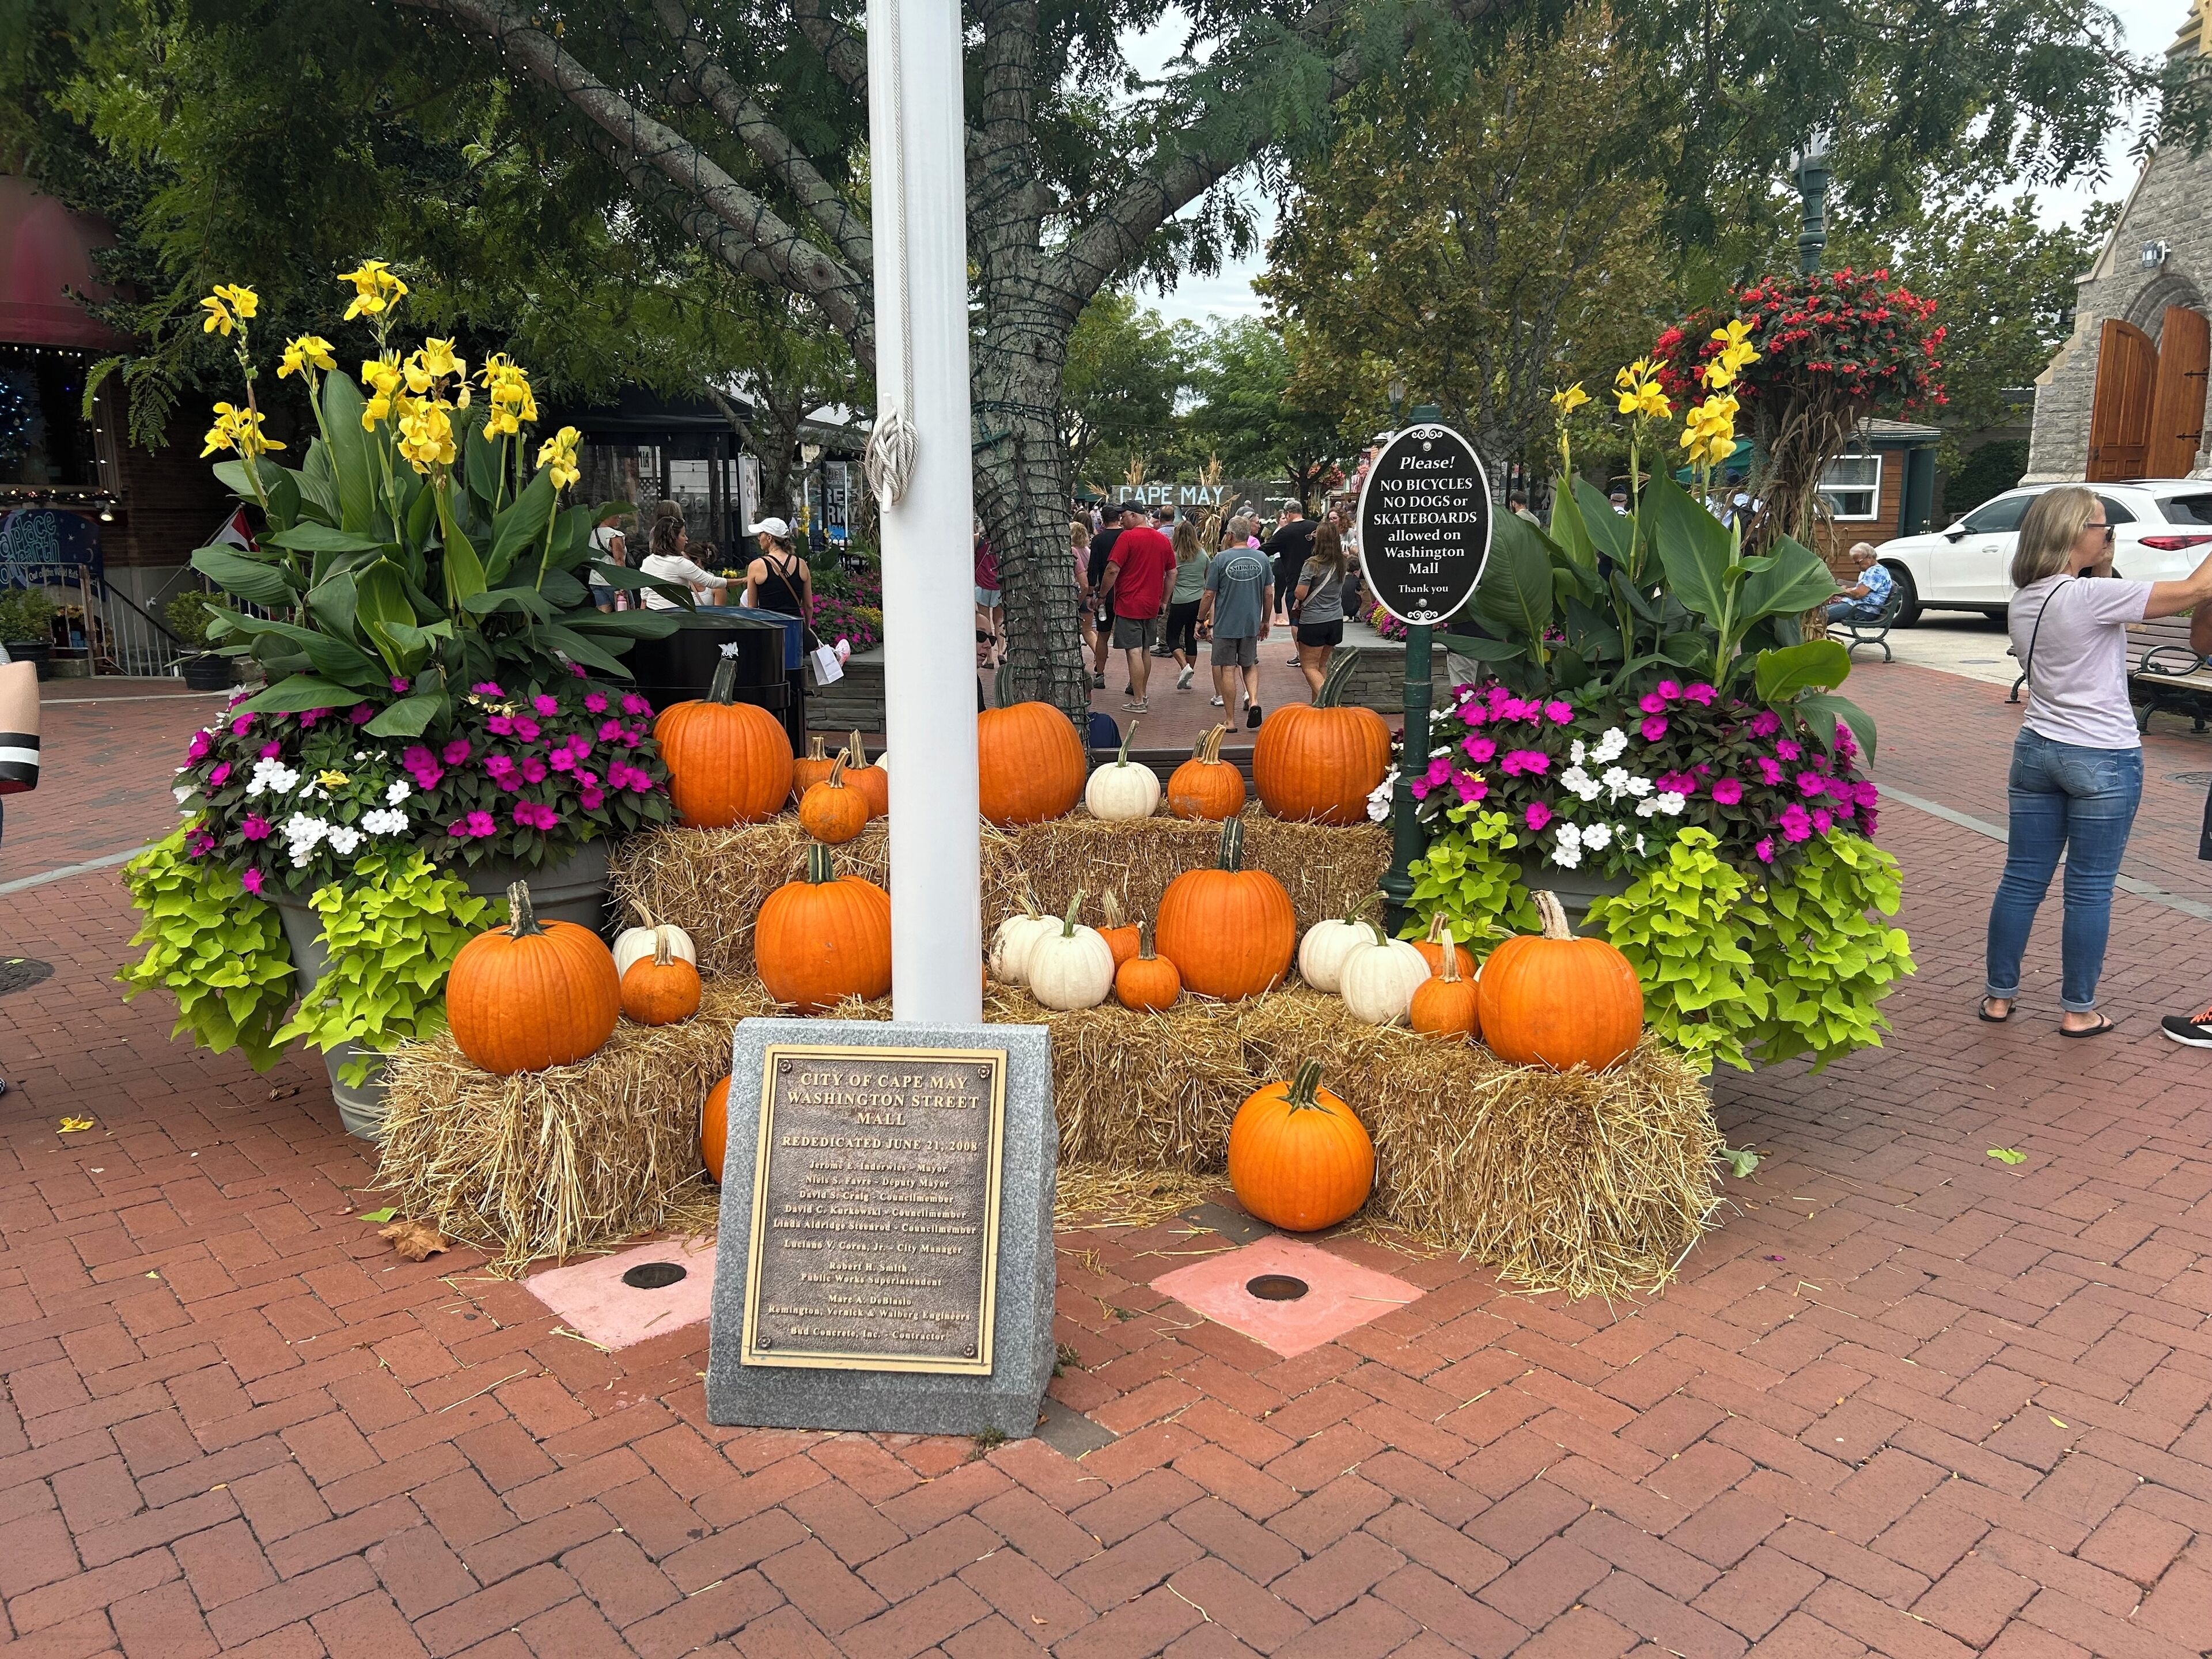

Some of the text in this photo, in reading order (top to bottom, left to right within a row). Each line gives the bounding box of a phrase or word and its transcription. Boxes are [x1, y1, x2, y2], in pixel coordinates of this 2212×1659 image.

[1399, 456, 1455, 470] Please!
[1380, 478, 1472, 491] NO BICYCLES
[1120, 486, 1224, 505] CAPE MAY
[1383, 495, 1468, 508] NO DOGS or
[1374, 512, 1476, 525] SKATEBOARDS
[10, 512, 56, 554] place
[1388, 530, 1461, 541] allowed on
[17, 533, 60, 569] earth
[1384, 547, 1465, 560] Washington
[1409, 563, 1439, 574] Mall
[1399, 585, 1449, 594] Thank you
[801, 1073, 968, 1090] CITY OF CAPE MAY
[787, 1092, 979, 1109] WASHINGTON STREET
[857, 1112, 906, 1126] MALL
[781, 1136, 978, 1152] REDEDICATED JUNE 21, 2008
[810, 1161, 843, 1170] Jerome
[860, 1162, 907, 1171] Inderwies
[917, 1164, 948, 1173] Mayor
[882, 1179, 915, 1188] Deputy
[919, 1180, 949, 1188] Mayor
[800, 1190, 827, 1199] David
[843, 1192, 869, 1202] Craig
[880, 1193, 954, 1203] Councilmember
[785, 1205, 812, 1213] David
[816, 1206, 826, 1214] C.
[830, 1207, 881, 1216] Kurkowski
[892, 1209, 967, 1218] Councilmember
[774, 1219, 801, 1228] Linda
[804, 1221, 846, 1231] Aldridge
[849, 1222, 891, 1231] Steenrod
[902, 1224, 976, 1234] Councilmember
[784, 1240, 823, 1249] Luciano
[827, 1241, 835, 1249] V.
[873, 1243, 886, 1251] Jr.
[897, 1244, 917, 1253] City
[922, 1245, 962, 1255] Manager
[830, 1262, 862, 1271] Robert
[865, 1263, 876, 1271] H.
[881, 1263, 907, 1272] Smith
[801, 1273, 942, 1286] Public Works Superintendent
[829, 1295, 853, 1304] Marc
[855, 1296, 866, 1304] A.
[768, 1305, 970, 1321] Remington, Vernick & Walberg Engineers
[791, 1327, 809, 1335] Bud
[813, 1328, 859, 1339] Concrete,
[863, 1330, 881, 1338] Inc.
[892, 1331, 946, 1340] Contractor
